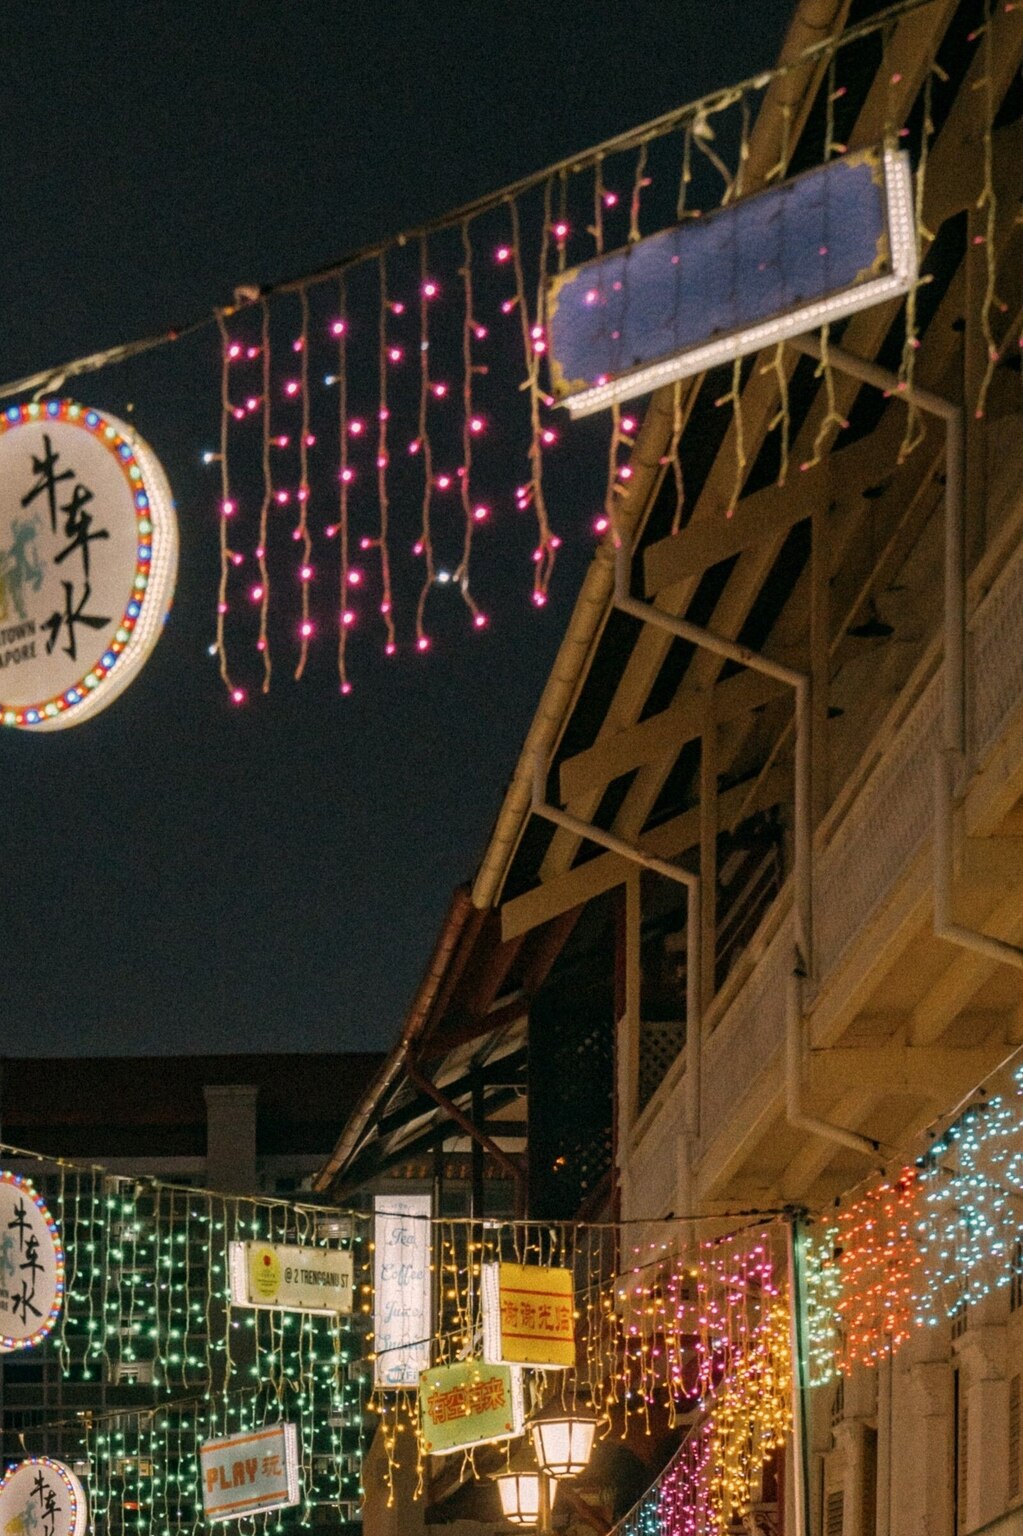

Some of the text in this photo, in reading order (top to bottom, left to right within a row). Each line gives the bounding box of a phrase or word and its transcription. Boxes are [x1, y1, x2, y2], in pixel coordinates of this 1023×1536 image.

[389, 1228, 416, 1247] Tea
[284, 1267, 293, 1284] @
[294, 1269, 299, 1284] 2
[300, 1269, 340, 1287] TRENGGANU
[341, 1273, 349, 1289] ST
[381, 1263, 423, 1286] Coffee
[206, 1457, 258, 1493] PLAY
